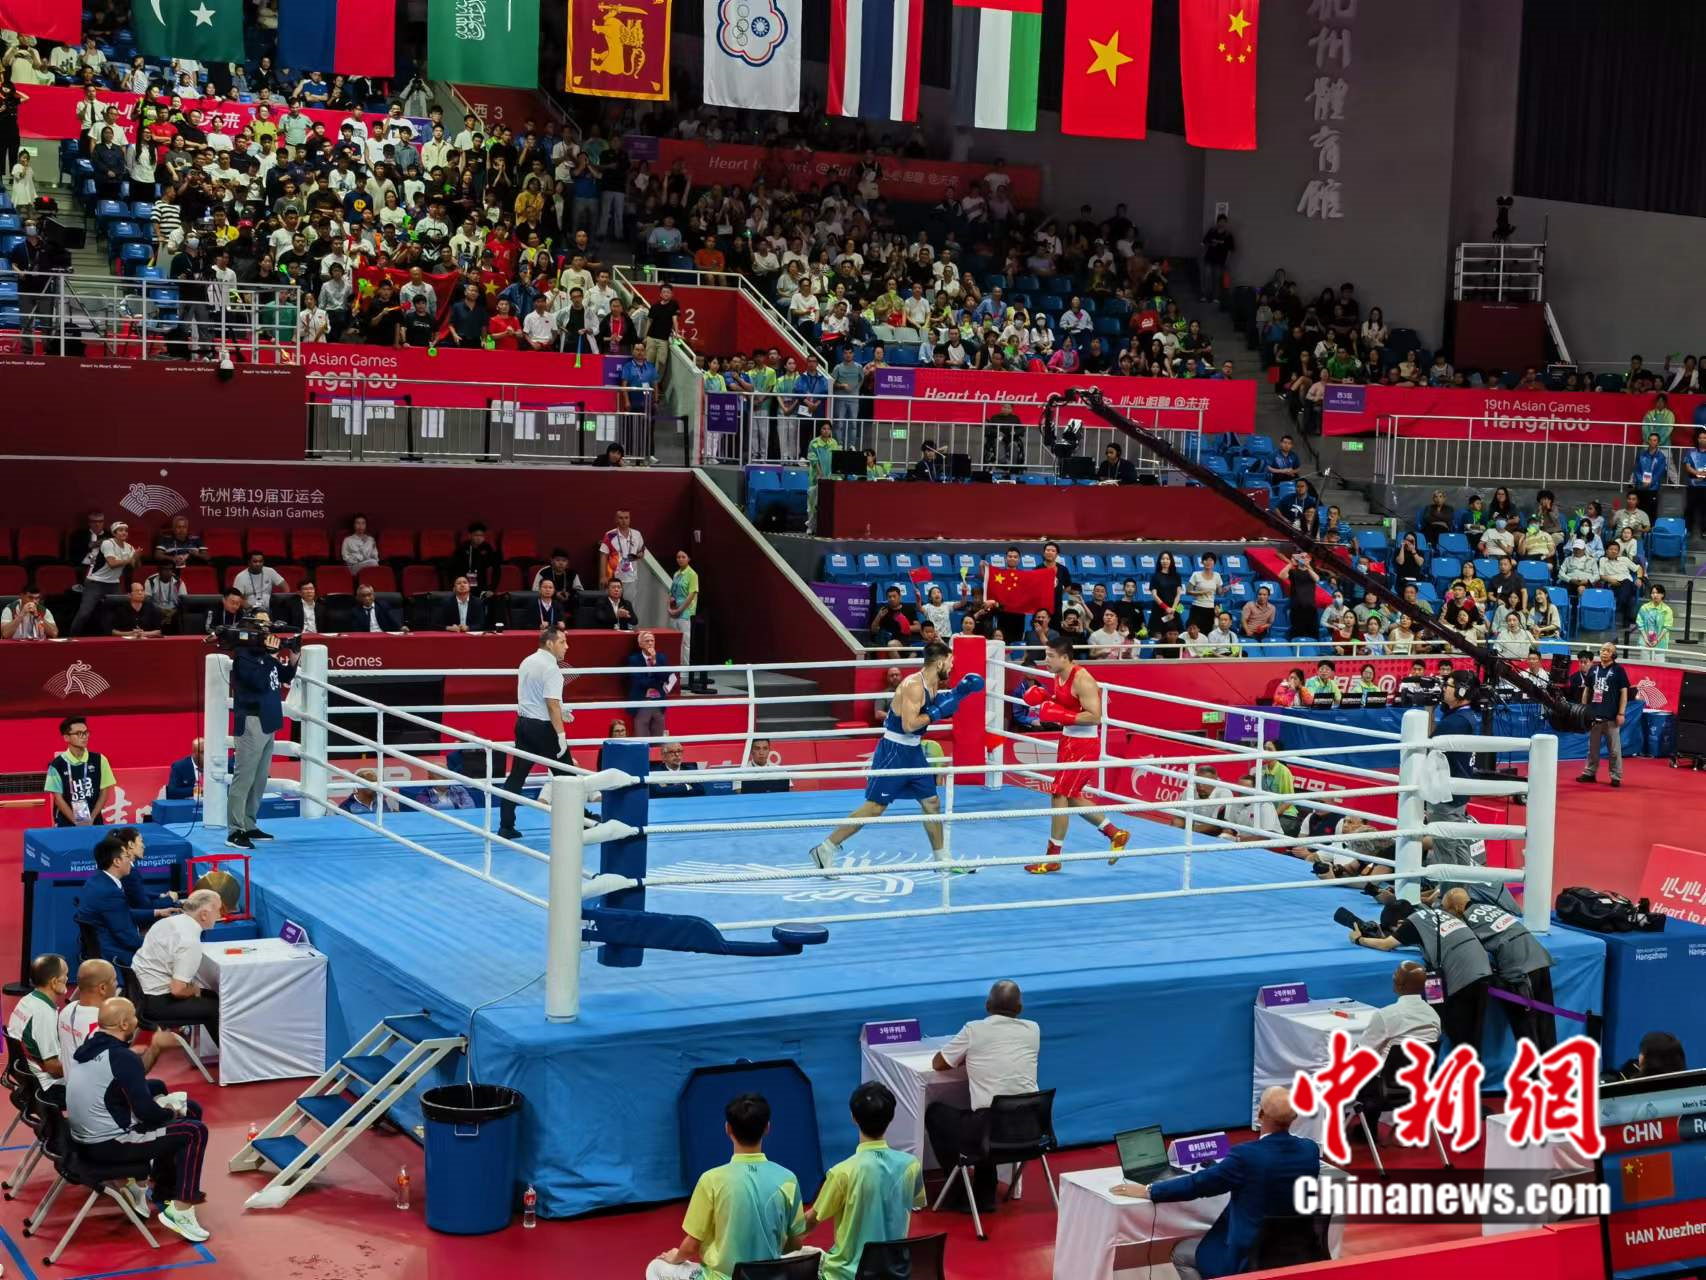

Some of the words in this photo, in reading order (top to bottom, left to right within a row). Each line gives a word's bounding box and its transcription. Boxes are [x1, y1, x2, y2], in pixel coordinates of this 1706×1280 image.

[474, 104, 489, 119] 西
[494, 106, 504, 120] 3
[684, 308, 696, 325] 2
[309, 352, 349, 367] Asian
[349, 353, 398, 368] Games
[307, 367, 398, 391] ngzhou
[1484, 399, 1511, 410] 19th
[1512, 400, 1547, 412] Asian
[1548, 401, 1591, 413] Games
[1482, 410, 1591, 432] Hangzhou
[199, 487, 325, 505] 杭州第19届亚运会
[199, 506, 221, 517] The
[224, 506, 249, 517] 19th
[252, 506, 283, 518] Asian
[286, 506, 325, 519] Games
[336, 655, 383, 667] Games
[71, 862, 98, 872] Hangz
[1687, 909, 1700, 923] to
[1622, 1120, 1663, 1145] CHN
[1625, 1227, 1655, 1246] HAN
